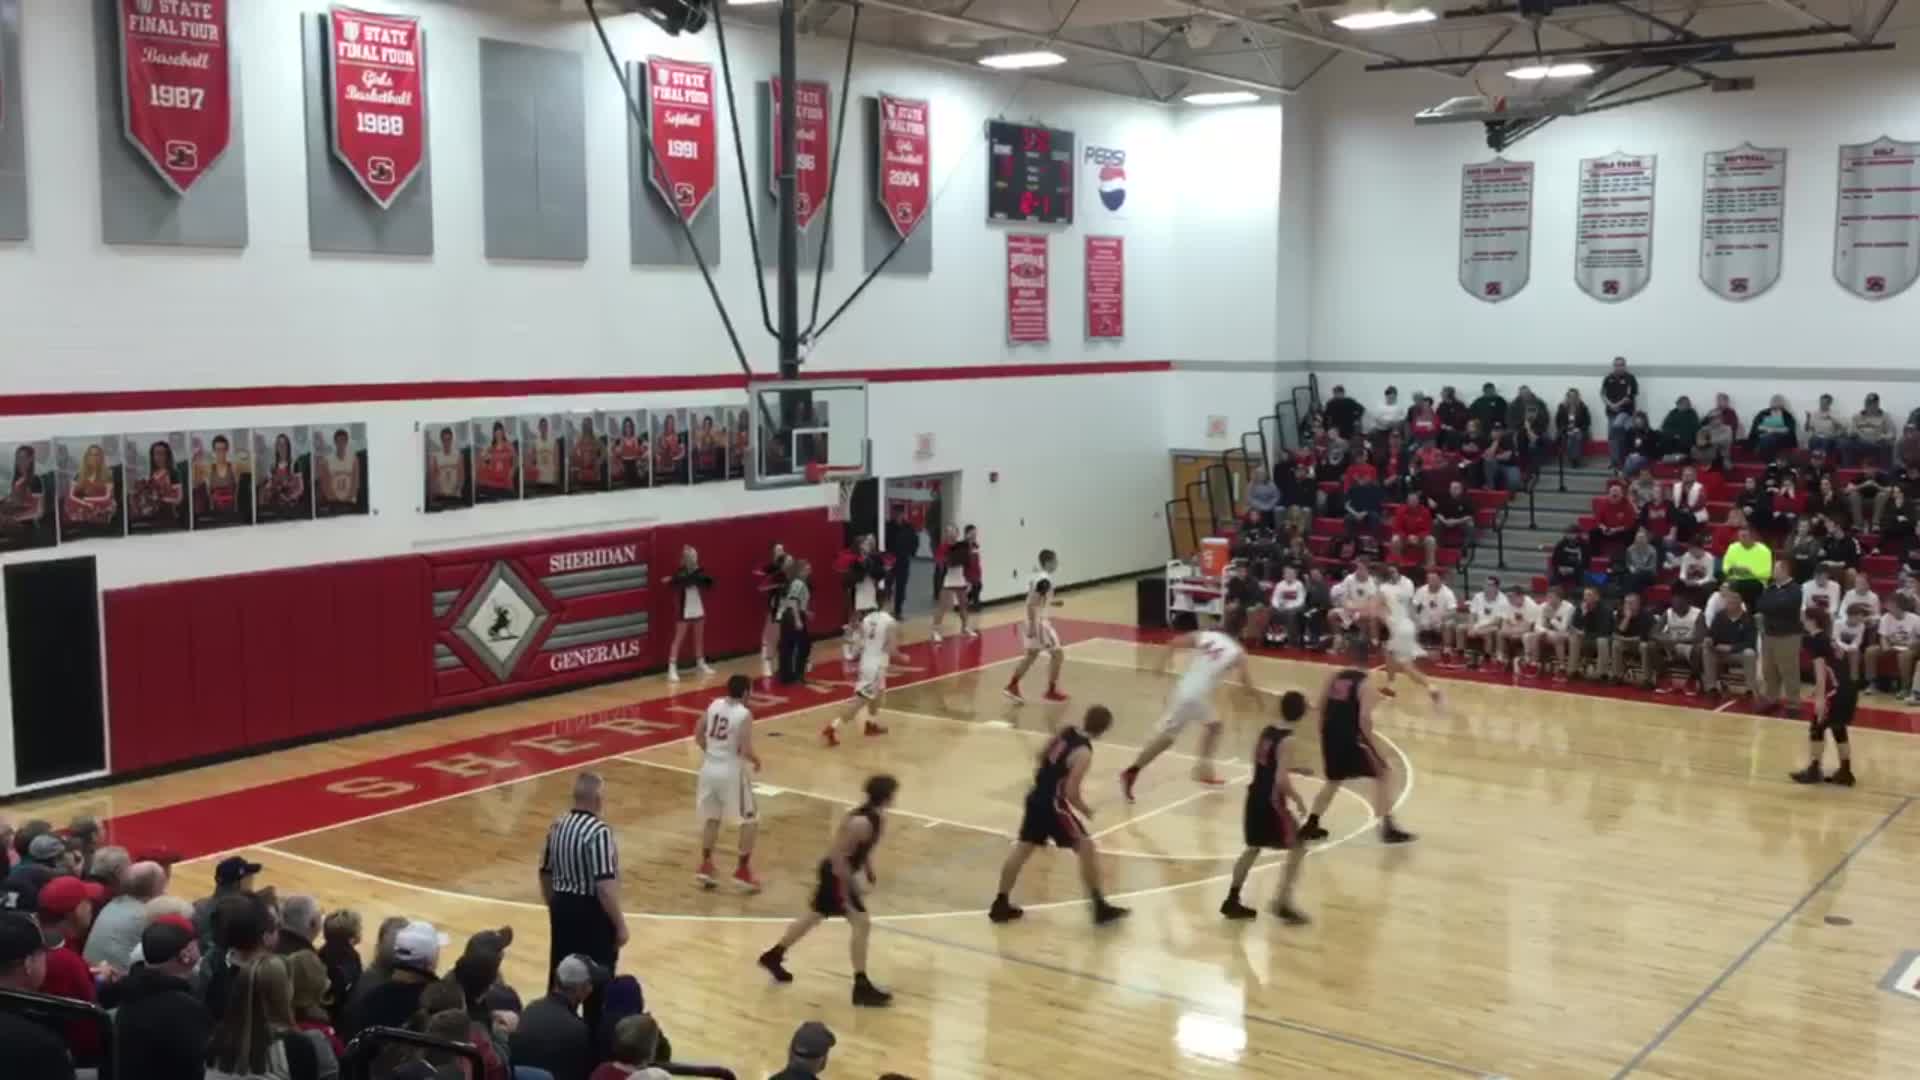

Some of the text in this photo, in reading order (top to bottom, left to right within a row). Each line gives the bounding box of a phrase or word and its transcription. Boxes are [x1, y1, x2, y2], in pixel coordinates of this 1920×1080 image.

[159, 0, 212, 19] STATE
[128, 15, 219, 41] FINAL FOUR
[363, 26, 408, 46] STATE
[141, 47, 209, 69] Baseball
[337, 41, 415, 66] FINAL FOUR
[150, 84, 205, 110] 1987
[356, 112, 403, 136] 1988
[667, 138, 698, 159] 1991
[1084, 146, 1126, 168] PEPSI
[549, 544, 638, 572] SHERIDAN
[550, 640, 640, 671] GENERALS
[708, 712, 729, 741] 12
